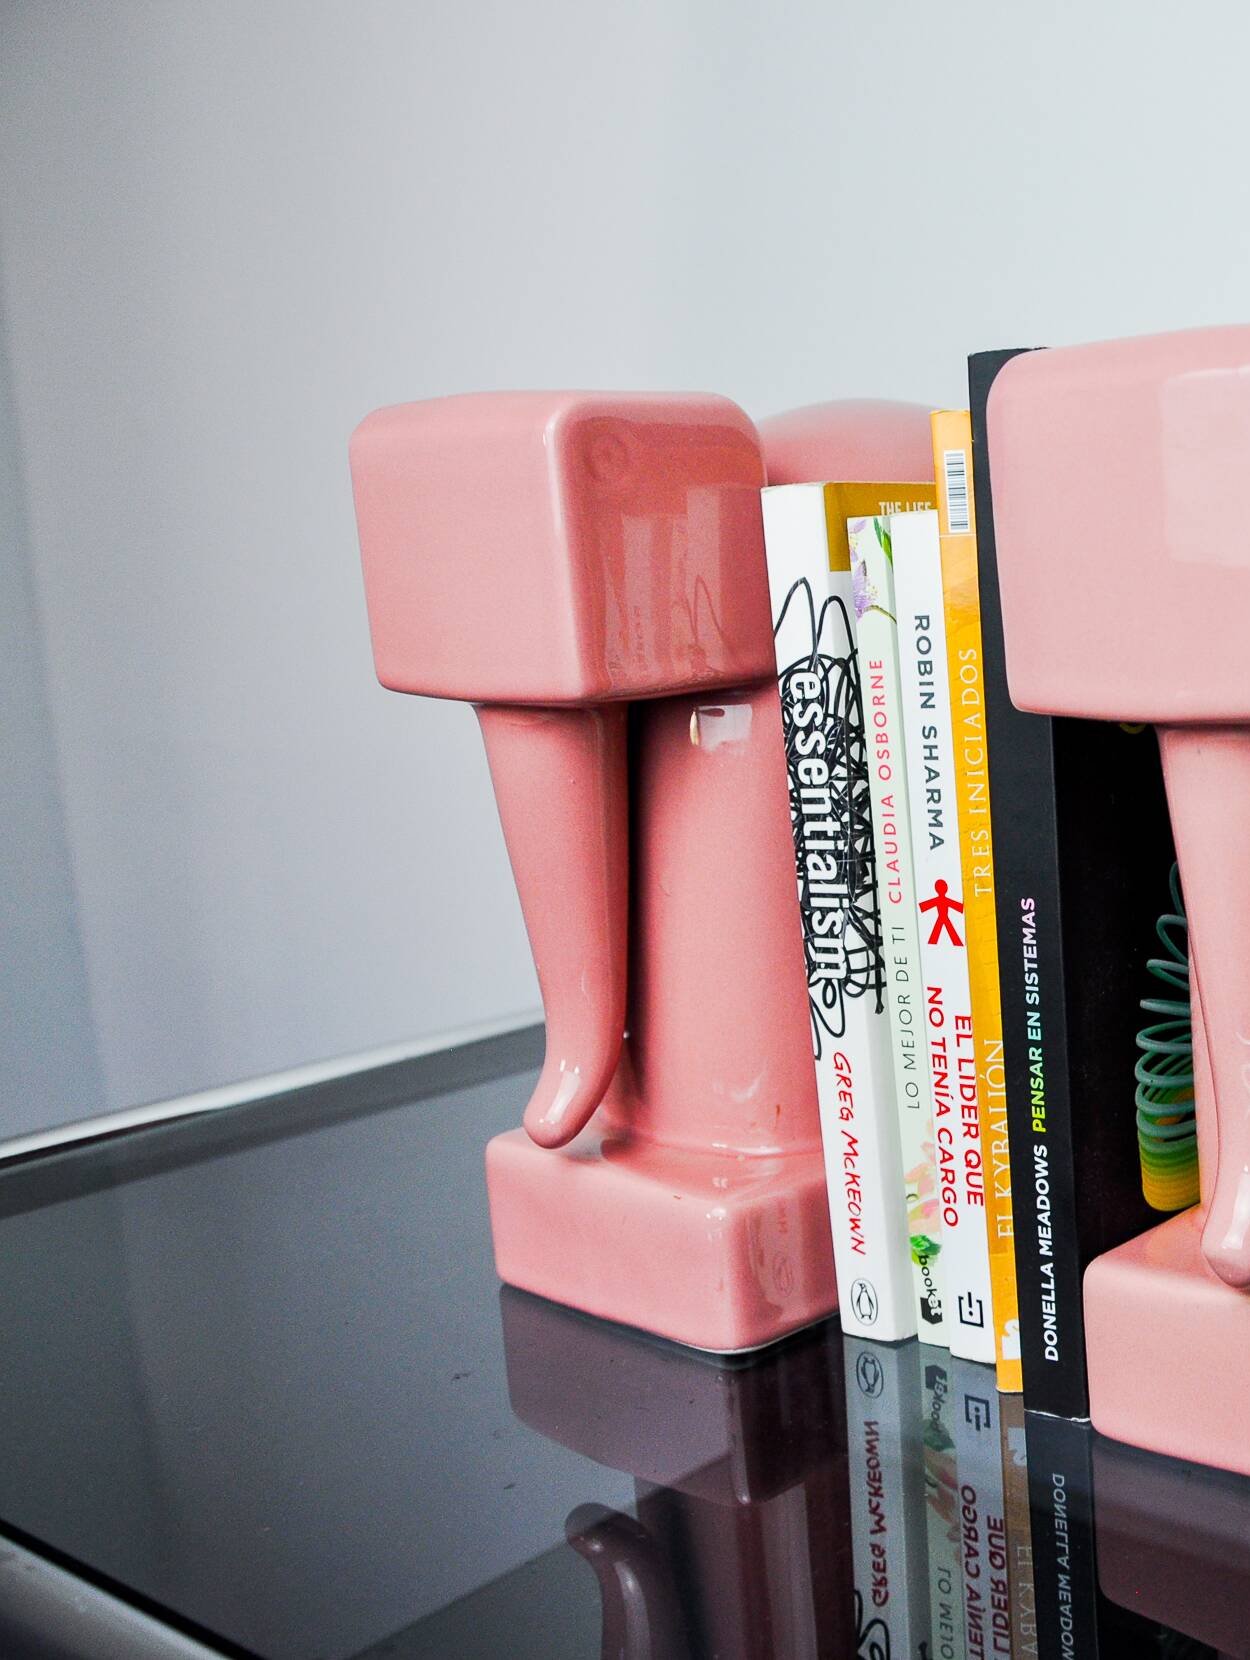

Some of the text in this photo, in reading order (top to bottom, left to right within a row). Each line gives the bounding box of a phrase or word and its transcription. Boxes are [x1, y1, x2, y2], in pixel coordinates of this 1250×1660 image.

[790, 671, 849, 980] essentialism
[869, 659, 902, 904] CLAUDIA OSBORNE
[914, 614, 945, 851] ROBIN SHARMA
[958, 648, 993, 897] TRES INICIADOS
[833, 1051, 854, 1122] GREG
[891, 926, 920, 1109] LO MEJOR DE TI
[926, 986, 959, 1227] NO TENÍA CARGO
[955, 1015, 973, 1048] EL
[1021, 897, 1047, 1133] PENSAR EN SISTEMAS
[963, 1149, 984, 1207] QUE
[1033, 1144, 1059, 1362] DONELLA MEADOWS
